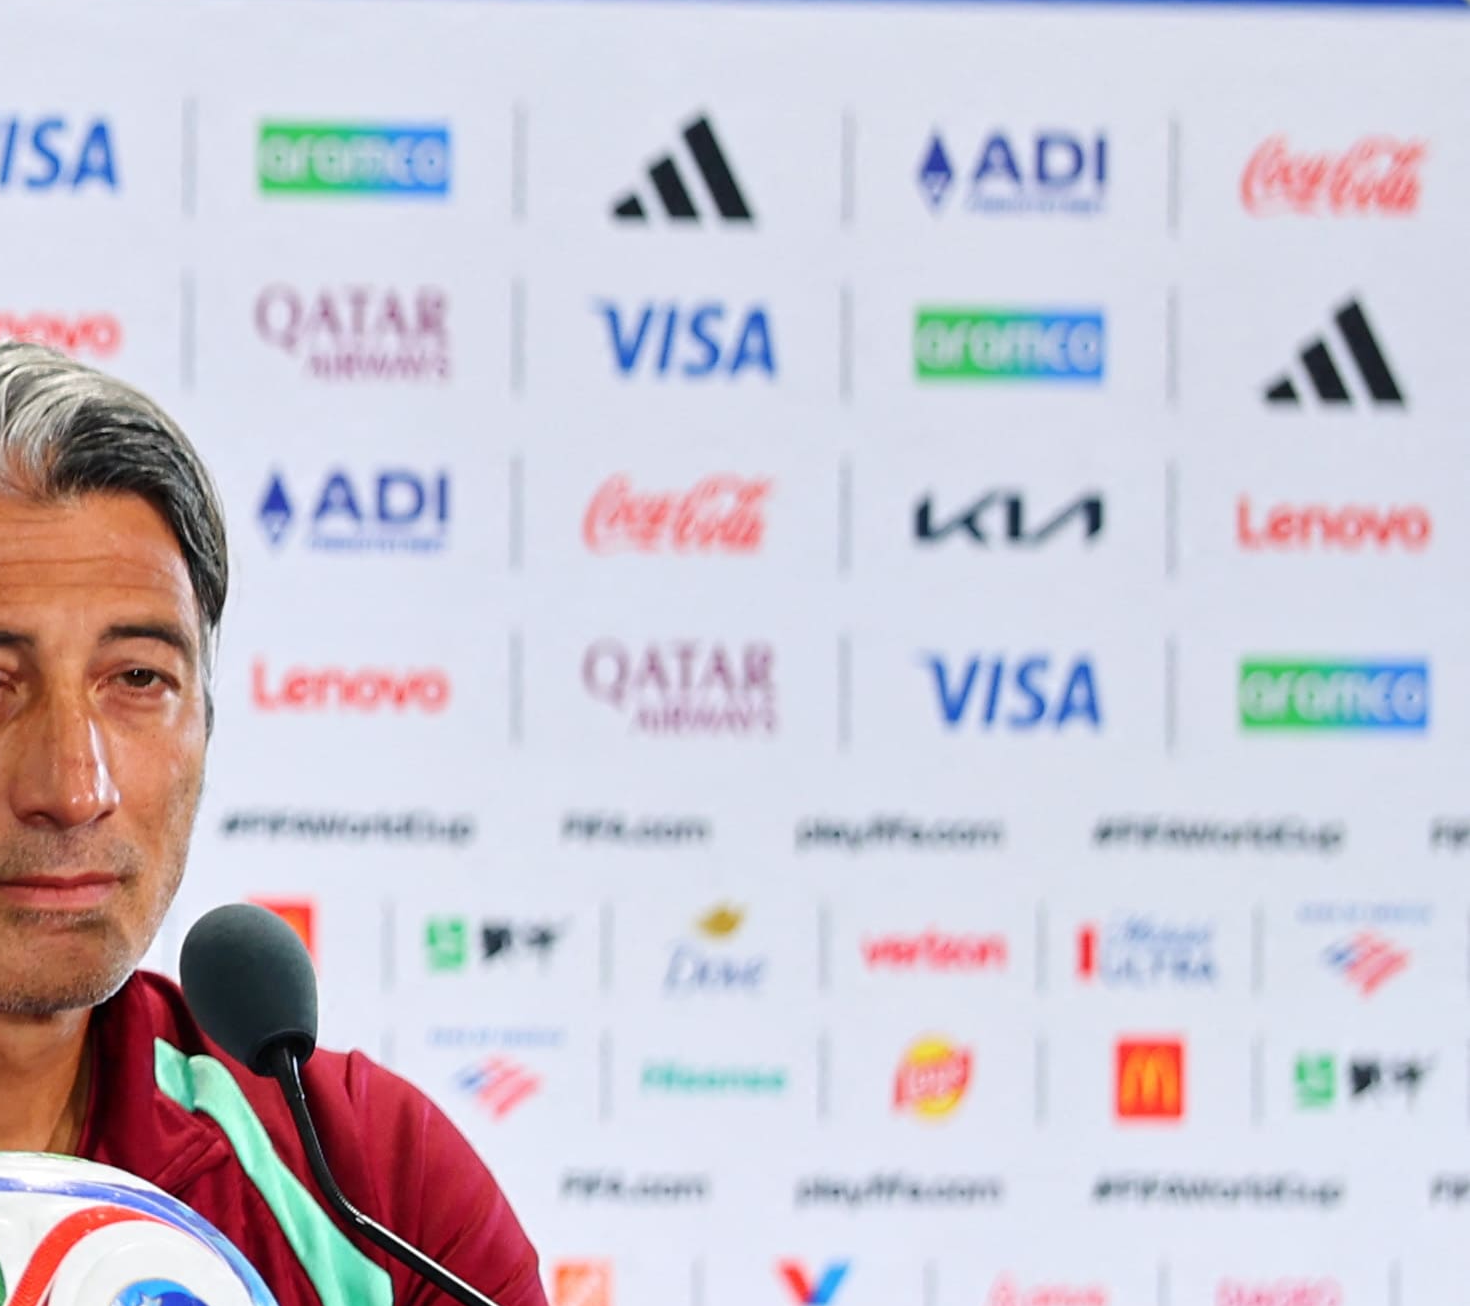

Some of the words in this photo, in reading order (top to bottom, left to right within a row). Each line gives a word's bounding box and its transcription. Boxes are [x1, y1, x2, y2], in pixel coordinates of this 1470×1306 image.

[258, 131, 449, 187] aramco
[971, 132, 1108, 185] ADI
[601, 304, 777, 378] VISA
[311, 470, 450, 525] ADI
[1236, 497, 1433, 550] Lenovo
[928, 656, 1103, 729] VISA
